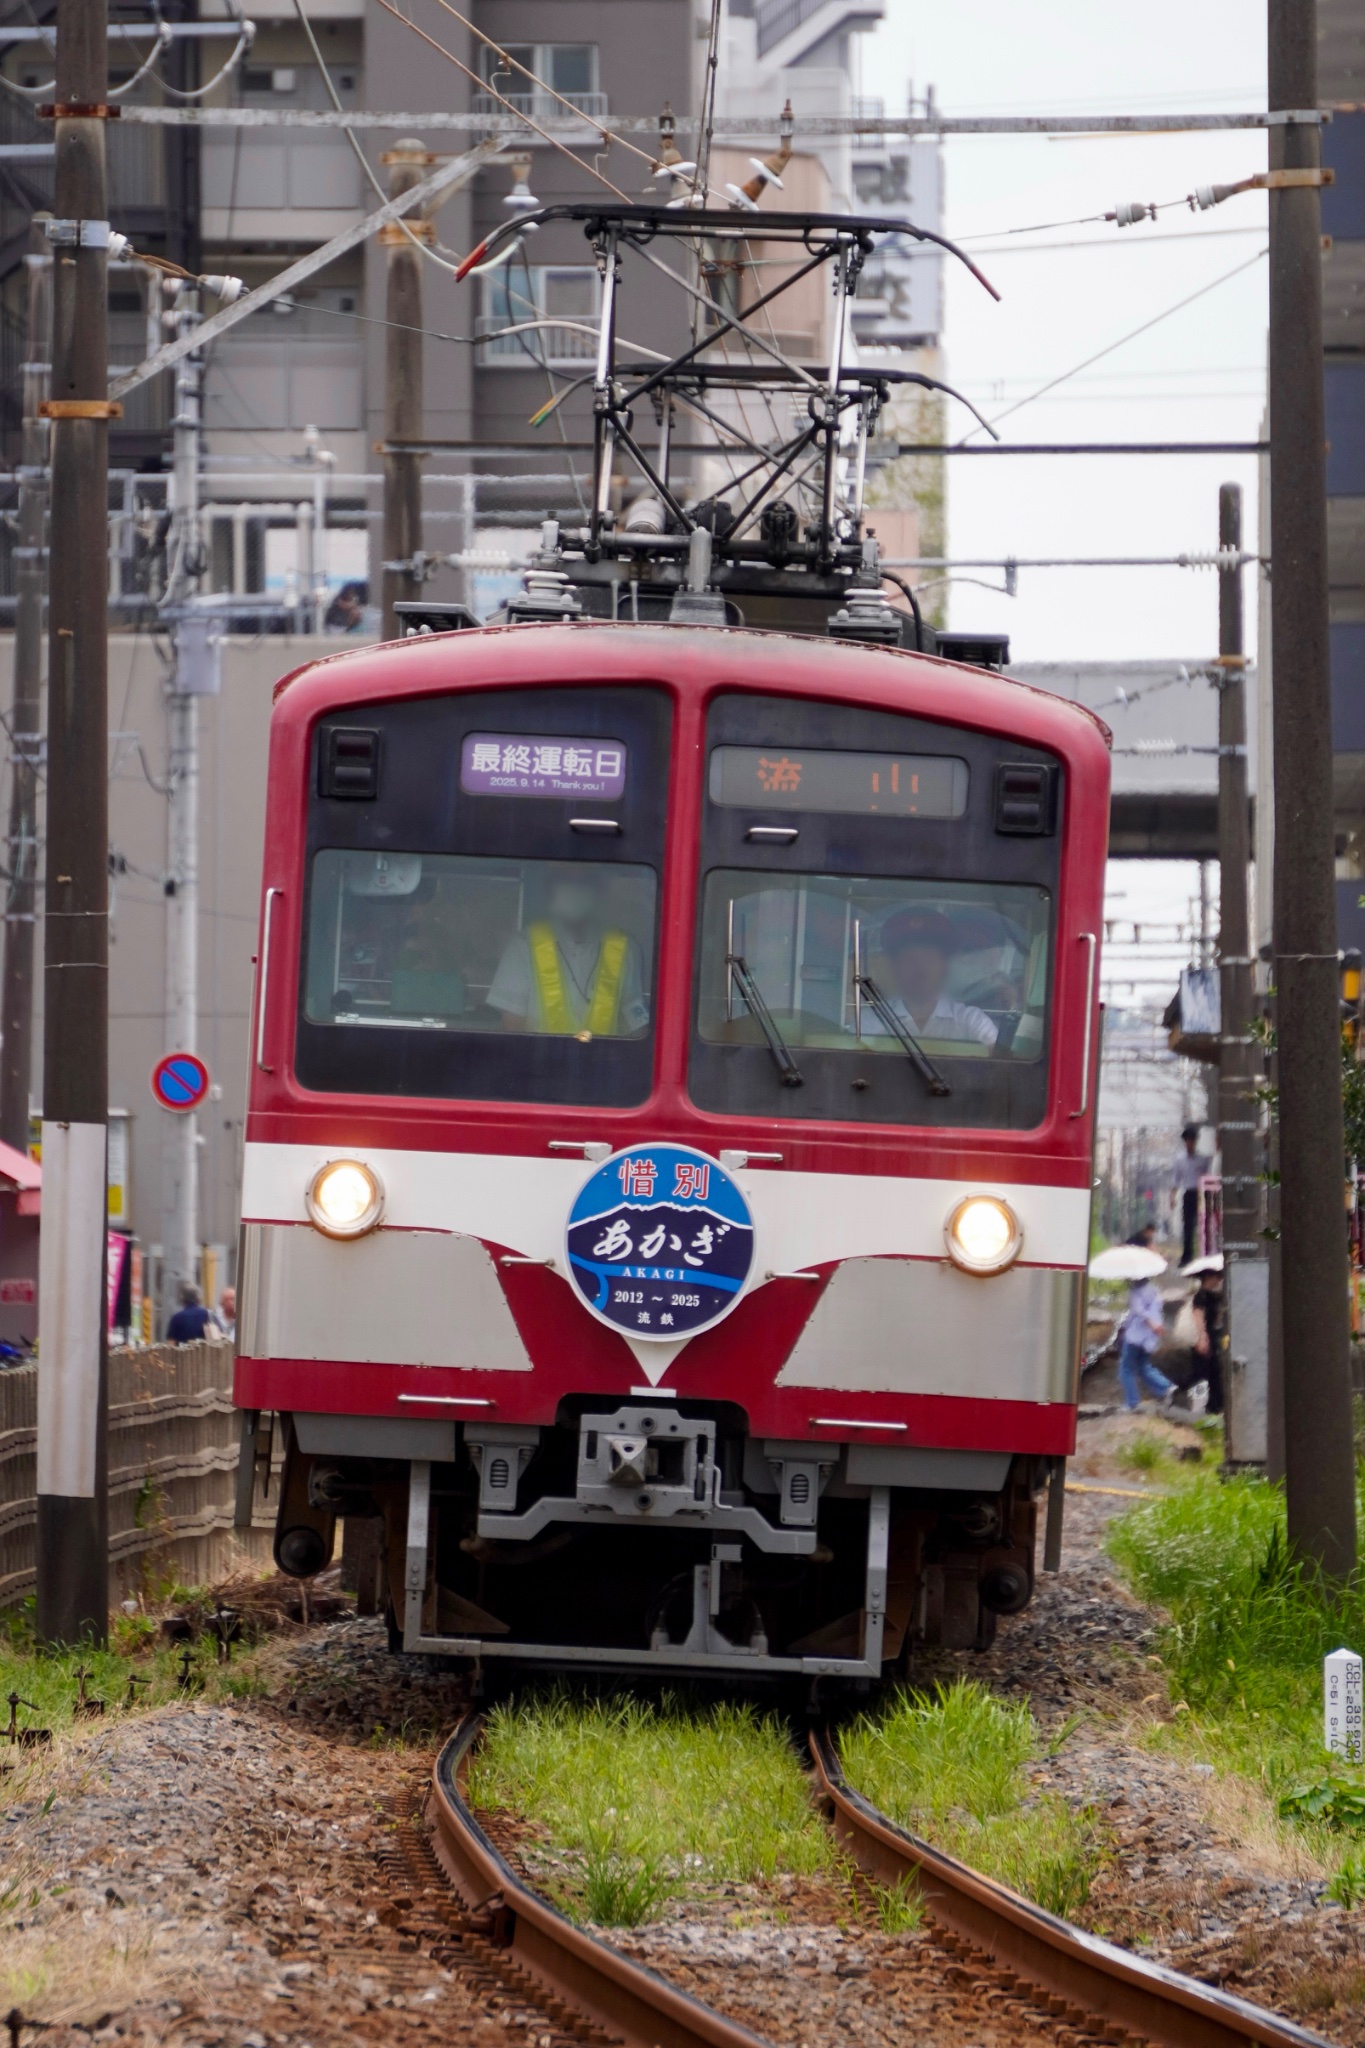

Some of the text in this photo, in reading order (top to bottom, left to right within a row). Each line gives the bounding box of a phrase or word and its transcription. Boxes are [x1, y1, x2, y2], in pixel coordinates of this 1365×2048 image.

[472, 743, 621, 777] 最終運転日
[552, 779, 580, 789] Thank
[618, 1158, 710, 1200] 惜別
[593, 1219, 730, 1266] あかぎ
[623, 1268, 685, 1280] AKAGI
[614, 1291, 644, 1304] 2012
[671, 1294, 700, 1307] 2025
[637, 1311, 674, 1325] 流鉄
